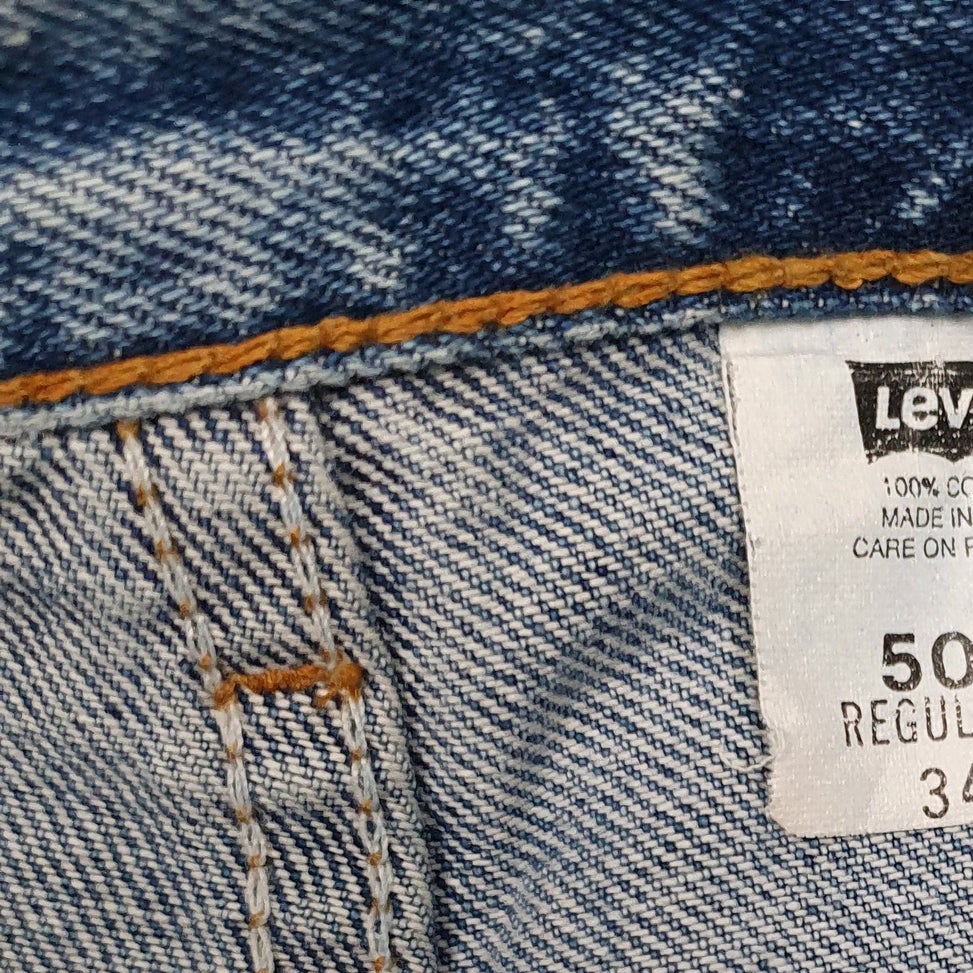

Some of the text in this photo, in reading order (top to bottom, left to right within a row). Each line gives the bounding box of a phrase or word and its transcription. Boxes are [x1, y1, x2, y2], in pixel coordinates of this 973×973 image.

[884, 475, 940, 498] 100%
[881, 506, 944, 529] MADE
[951, 506, 972, 528] IN
[852, 536, 916, 559] CARE
[923, 536, 956, 559] ON
